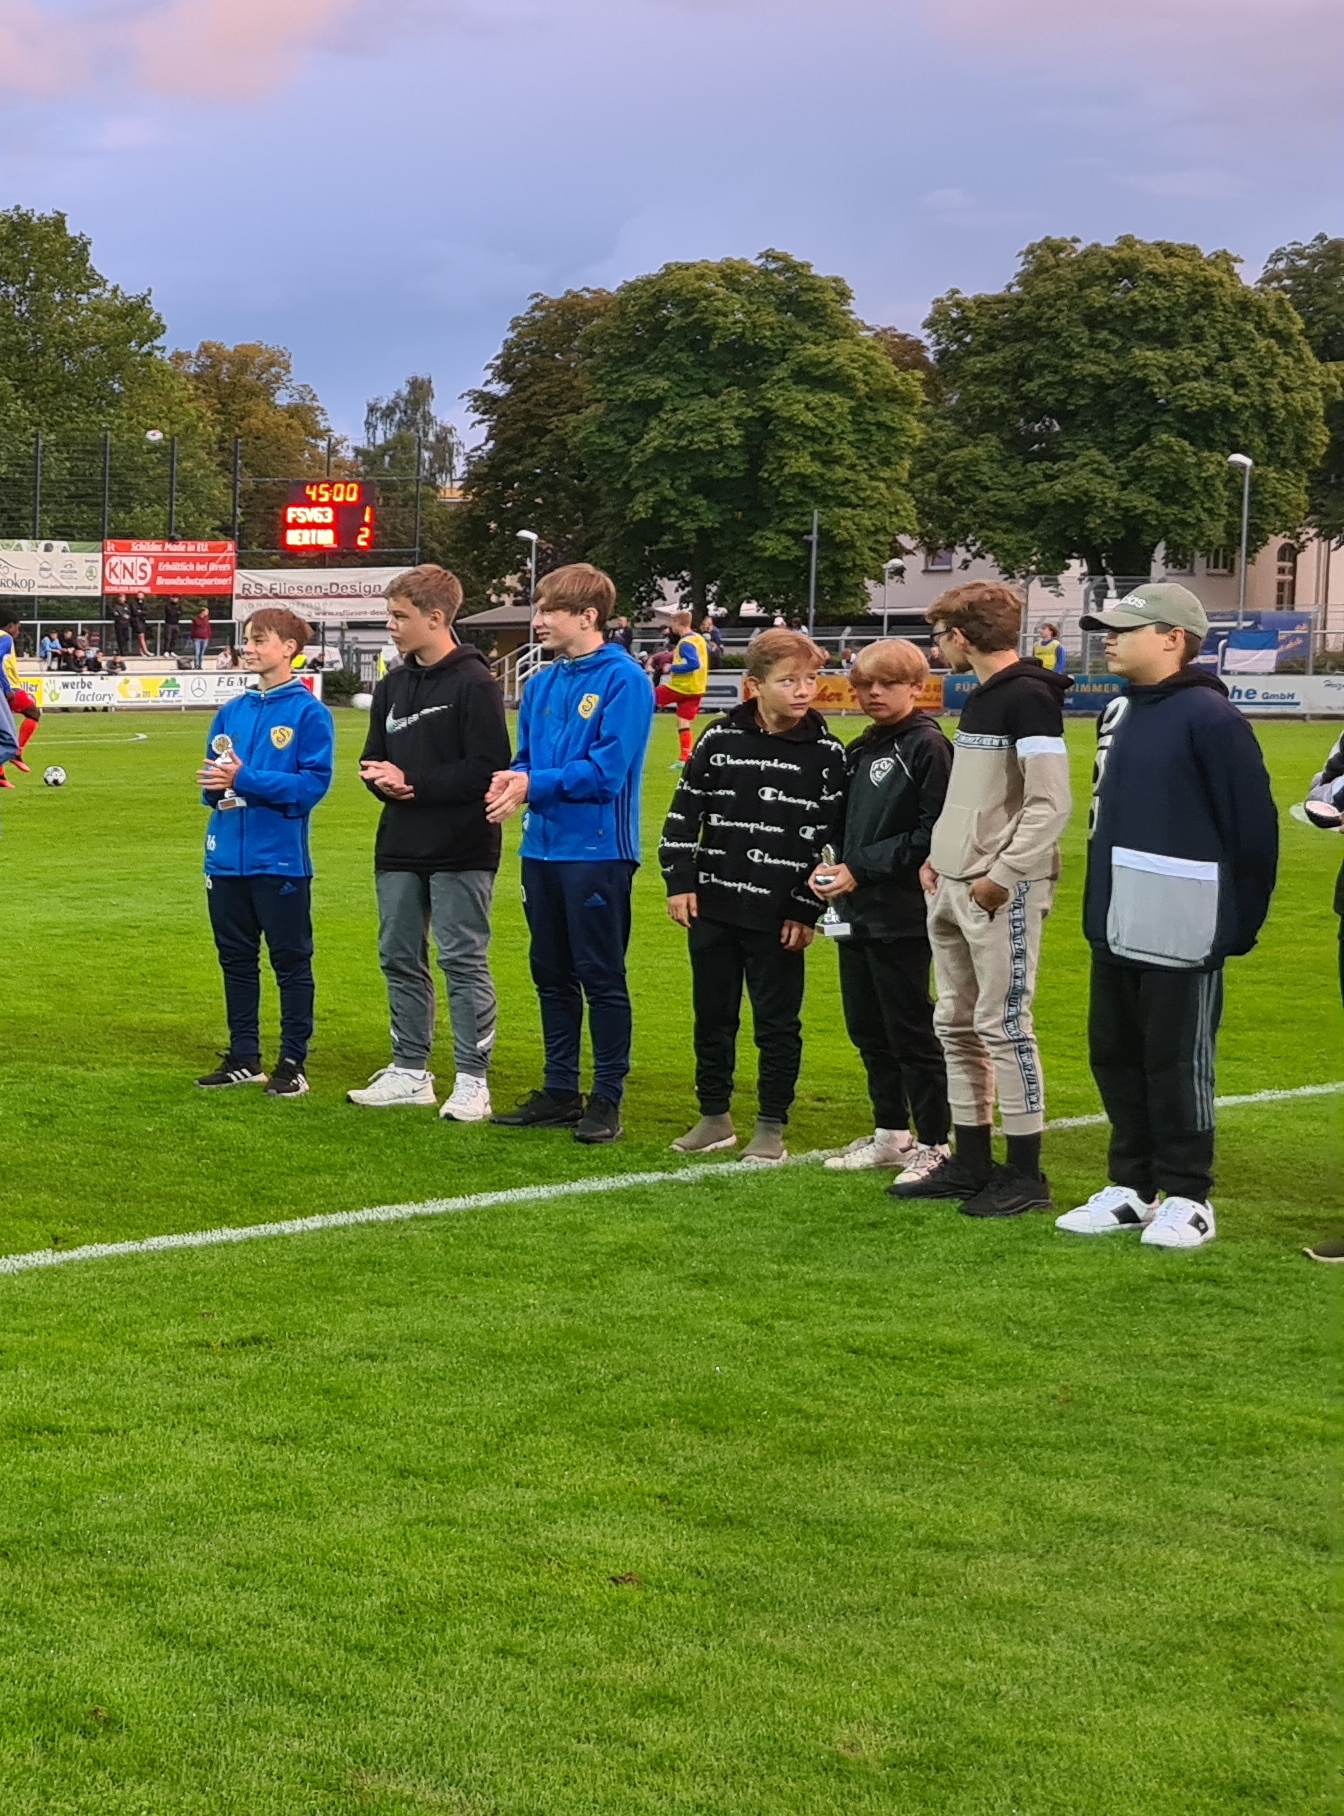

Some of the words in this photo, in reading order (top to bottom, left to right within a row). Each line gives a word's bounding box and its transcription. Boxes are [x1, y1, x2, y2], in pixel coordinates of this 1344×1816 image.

[305, 483, 358, 502] 45:00
[287, 507, 334, 523] FSV63
[364, 506, 371, 523] 1
[357, 527, 370, 546] 2
[109, 562, 148, 580] KNS
[242, 583, 262, 594] RS
[269, 581, 382, 597] Fliesen-Design
[62, 679, 92, 689] werbe
[75, 689, 114, 703] factory
[158, 689, 181, 698] VTF
[1262, 691, 1295, 700] GmbH
[710, 753, 801, 773] Champion
[698, 871, 772, 895] Champion
